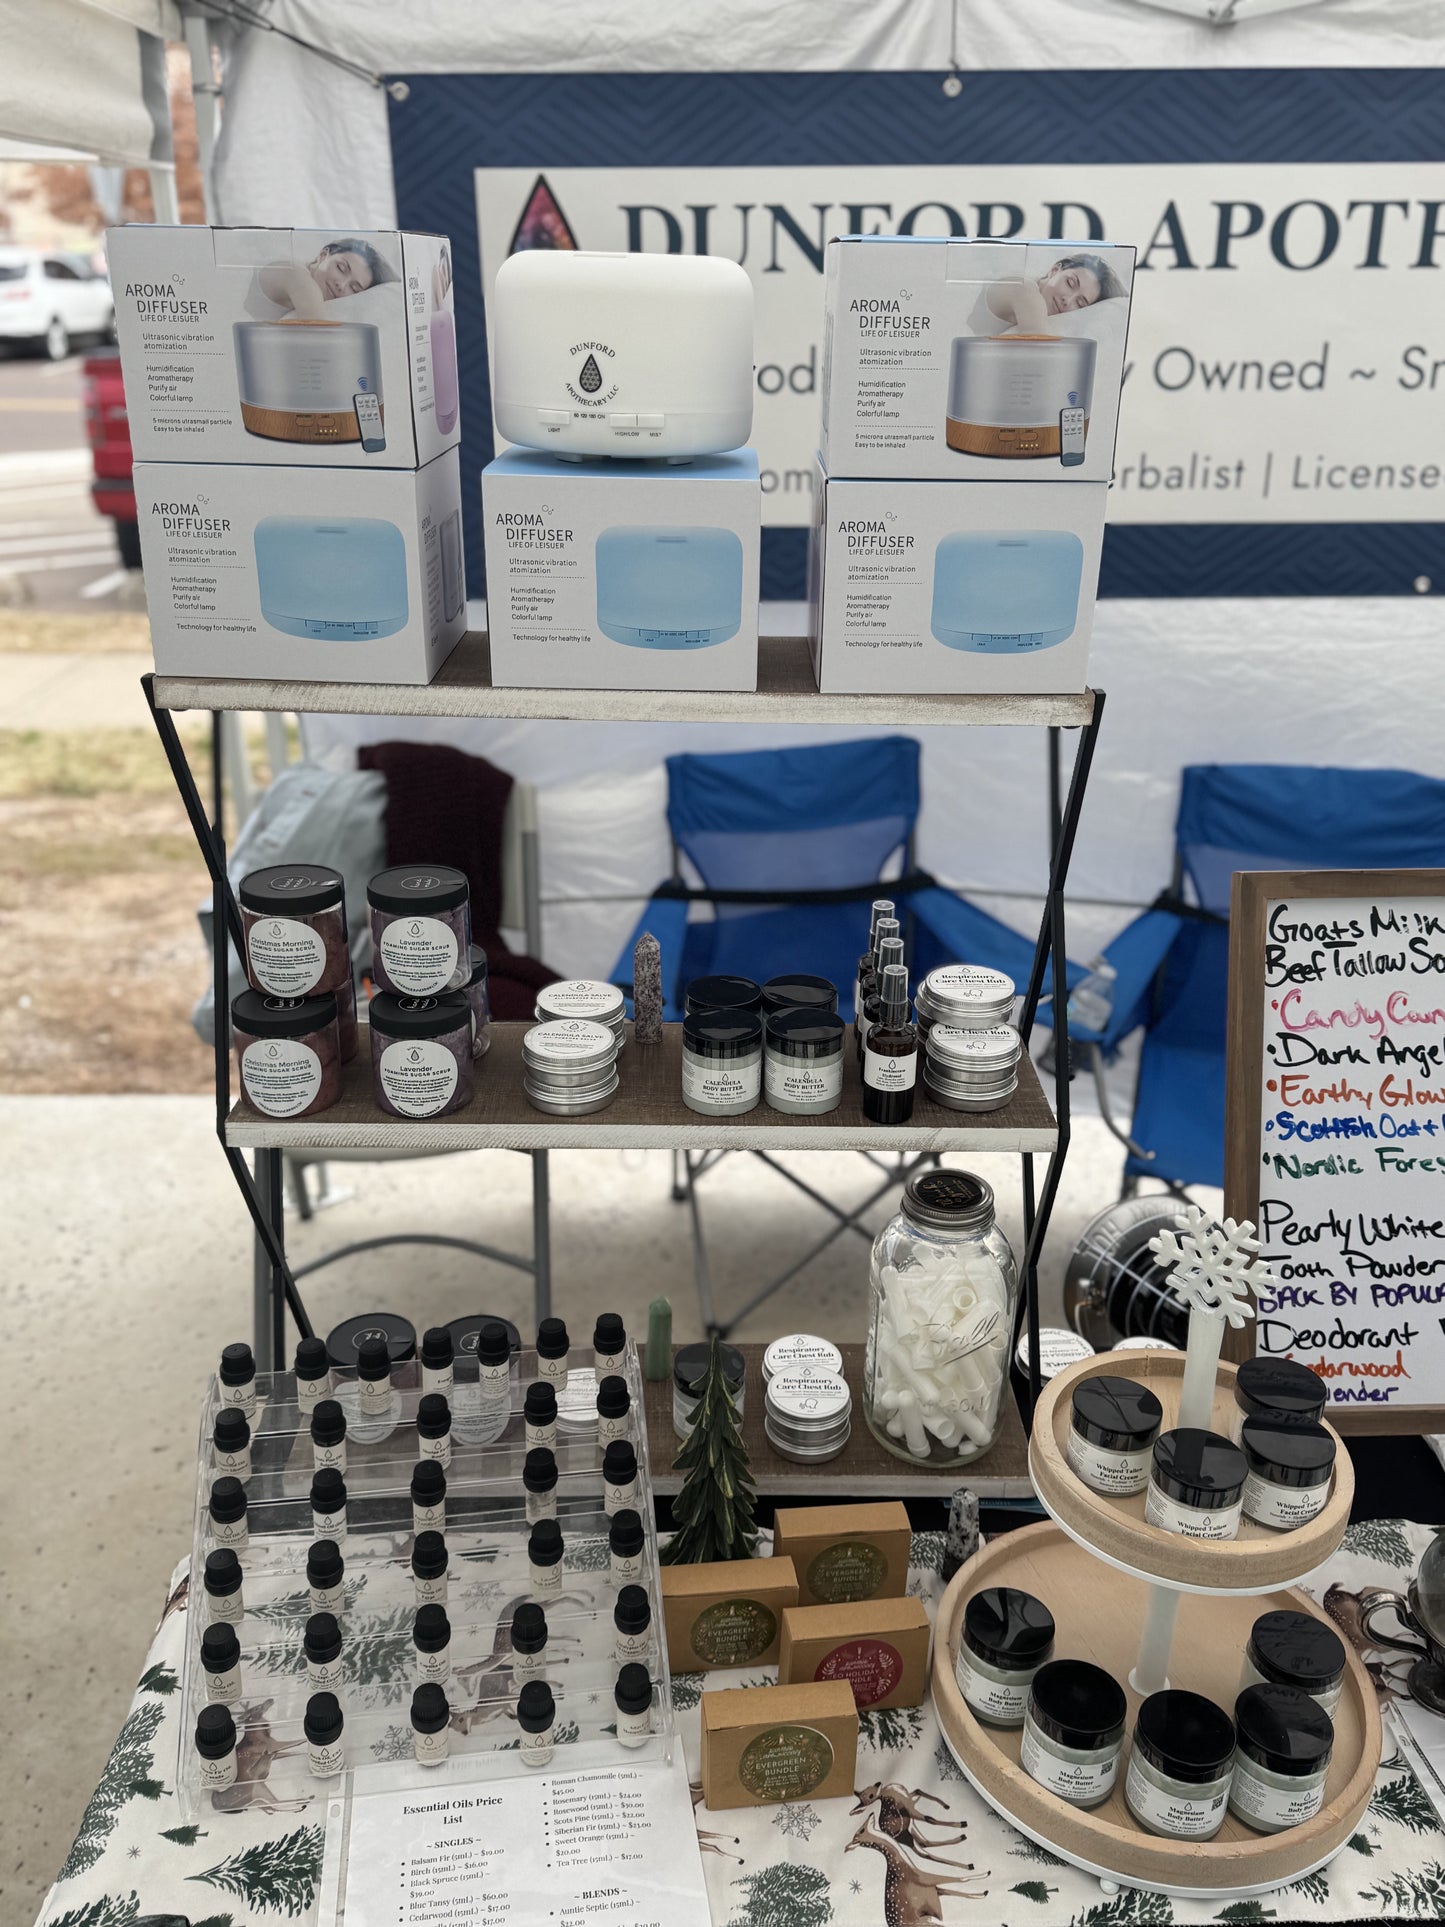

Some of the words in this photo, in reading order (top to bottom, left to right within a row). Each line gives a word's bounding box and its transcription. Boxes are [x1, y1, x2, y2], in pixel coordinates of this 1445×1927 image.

[125, 284, 176, 297] AROMA
[137, 300, 208, 314] DIFFUSER
[850, 299, 900, 312] AROMA
[859, 316, 930, 329] DIFFUSER
[569, 341, 616, 358] DUNFORD
[898, 349, 932, 357] vibration
[1153, 341, 1329, 392] Owned
[565, 382, 607, 406] APOTHECARY
[607, 384, 619, 399] LLC
[858, 390, 904, 398] Aromatherapy
[857, 400, 876, 408] Purify
[1120, 452, 1246, 489] rbalist
[1292, 453, 1445, 490] License
[152, 503, 200, 515] AROMA
[162, 518, 230, 531] DIFFUSER
[496, 513, 544, 526] AROMA
[839, 521, 886, 533] AROMA
[506, 528, 573, 541] DIFFUSER
[848, 536, 914, 548] DIFFUSER
[513, 634, 548, 642] Technology
[558, 635, 580, 643] healthy
[1268, 903, 1365, 943] Goats
[1370, 905, 1445, 937] Milk
[251, 937, 280, 947] Christmas
[1265, 943, 1326, 987] Beef
[1332, 949, 1406, 978] Tallow
[1280, 988, 1388, 1040] Candy
[1274, 1032, 1370, 1067] Dark
[1377, 1034, 1445, 1078] Ange
[1280, 1074, 1372, 1110] Earthy
[1379, 1112, 1420, 1138] Oat
[1273, 1153, 1363, 1180] Nordic
[1259, 1199, 1351, 1250] Pearly
[1339, 1250, 1445, 1279] Powder
[1258, 1285, 1325, 1313] BACK
[1329, 1281, 1358, 1306] BY
[1257, 1317, 1420, 1354] Deodorant
[1300, 1350, 1411, 1379] darwood
[1326, 1380, 1399, 1402] ender
[1097, 1464, 1123, 1474] Whipped
[756, 1757, 806, 1770] EVERGREEN
[765, 1766, 800, 1776] BUNDLE
[552, 1778, 576, 1786] Roman
[577, 1773, 616, 1782] Chamomile
[552, 1788, 574, 1796] $45.00
[403, 1801, 449, 1815] Essential
[452, 1800, 473, 1809] Oils
[476, 1796, 503, 1807] Price
[553, 1795, 587, 1805] Rosemary
[589, 1793, 611, 1801] (15mL)
[554, 1804, 588, 1815] Rosewood
[1169, 1806, 1205, 1815] Magnesium
[443, 1815, 462, 1824] List
[554, 1817, 573, 1825] Scots
[1168, 1812, 1183, 1821] Body
[555, 1826, 584, 1835] Siberian
[434, 1837, 474, 1848] SINGLES
[555, 1838, 577, 1846] Sweet
[606, 1832, 628, 1840] (15mL)
[411, 1855, 437, 1866] Balsam
[590, 1855, 613, 1863] (15mL)
[411, 1867, 430, 1876] Birch
[432, 1864, 455, 1874] (15mL)
[411, 1878, 431, 1887] Black
[432, 1875, 458, 1885] Spruce
[460, 1871, 483, 1881] (15mL)
[410, 1890, 435, 1899] $39.00
[582, 1888, 620, 1900] BLENDS
[410, 1902, 426, 1910] Blue
[428, 1899, 451, 1908] Tansy
[482, 1893, 508, 1901] $60.00
[560, 1906, 584, 1915] Auntie
[586, 1902, 608, 1912] Septic
[611, 1899, 634, 1908] (15mL)
[409, 1910, 453, 1922] Cedarwood
[455, 1907, 478, 1917] (15mL)
[488, 1904, 510, 1912] $17.00
